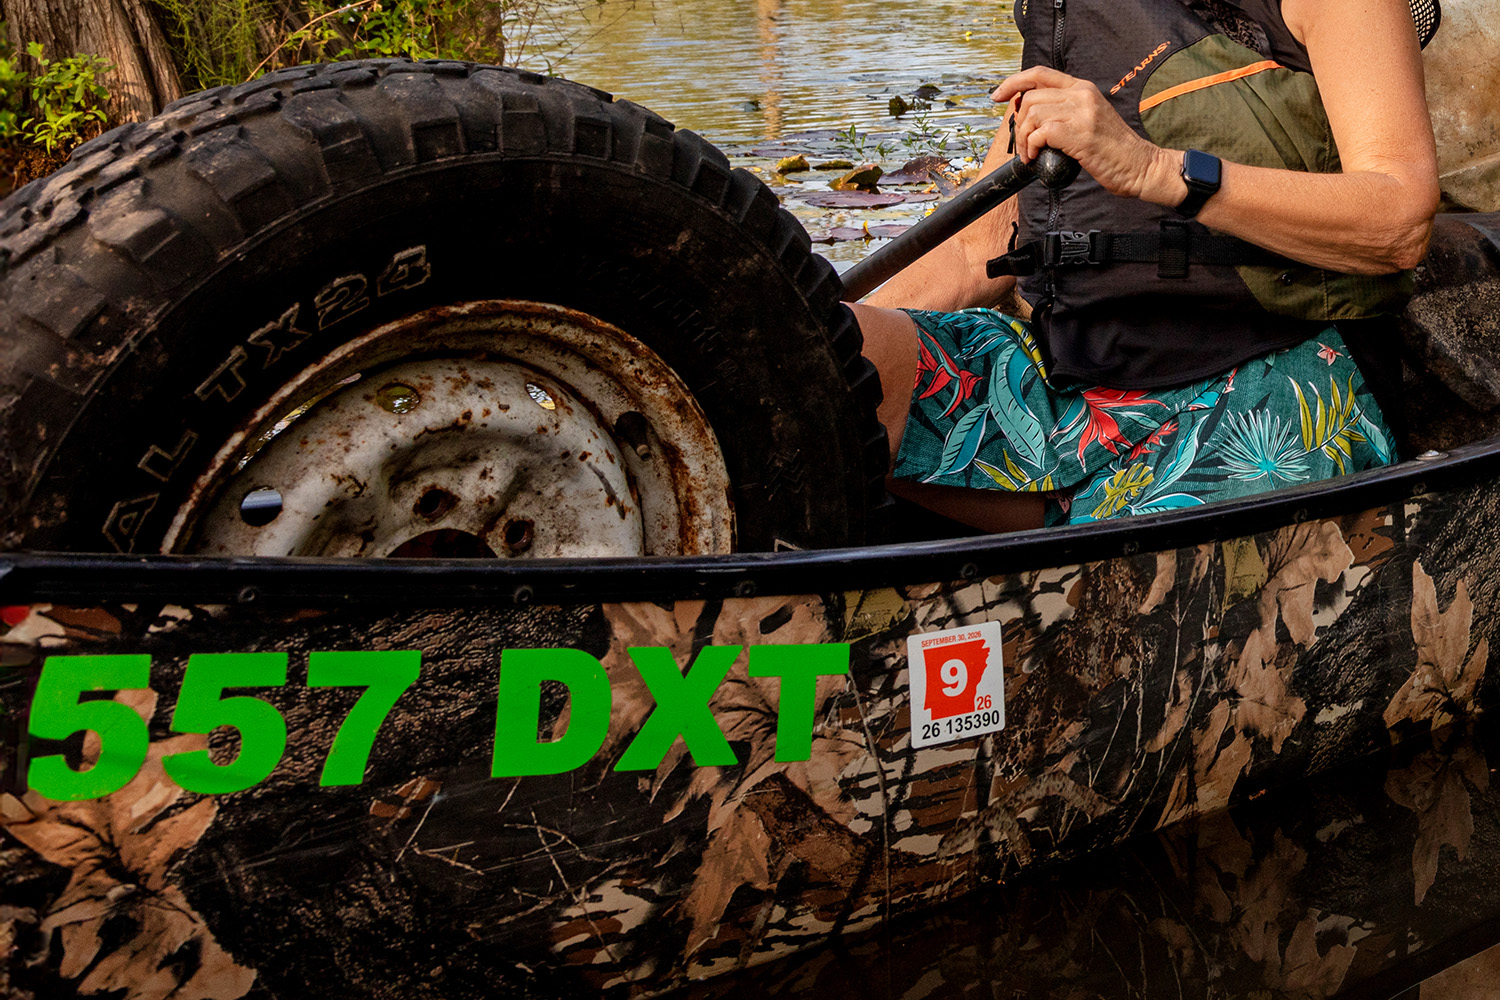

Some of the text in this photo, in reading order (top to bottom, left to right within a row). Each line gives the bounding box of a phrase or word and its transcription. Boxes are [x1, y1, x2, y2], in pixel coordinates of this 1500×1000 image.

[921, 635, 956, 648] SEPTEMBER
[967, 630, 982, 640] 2026
[940, 659, 968, 697] 9
[976, 695, 992, 710] 26
[26, 643, 851, 801] 557 DXT
[922, 710, 1000, 740] 26 135390
